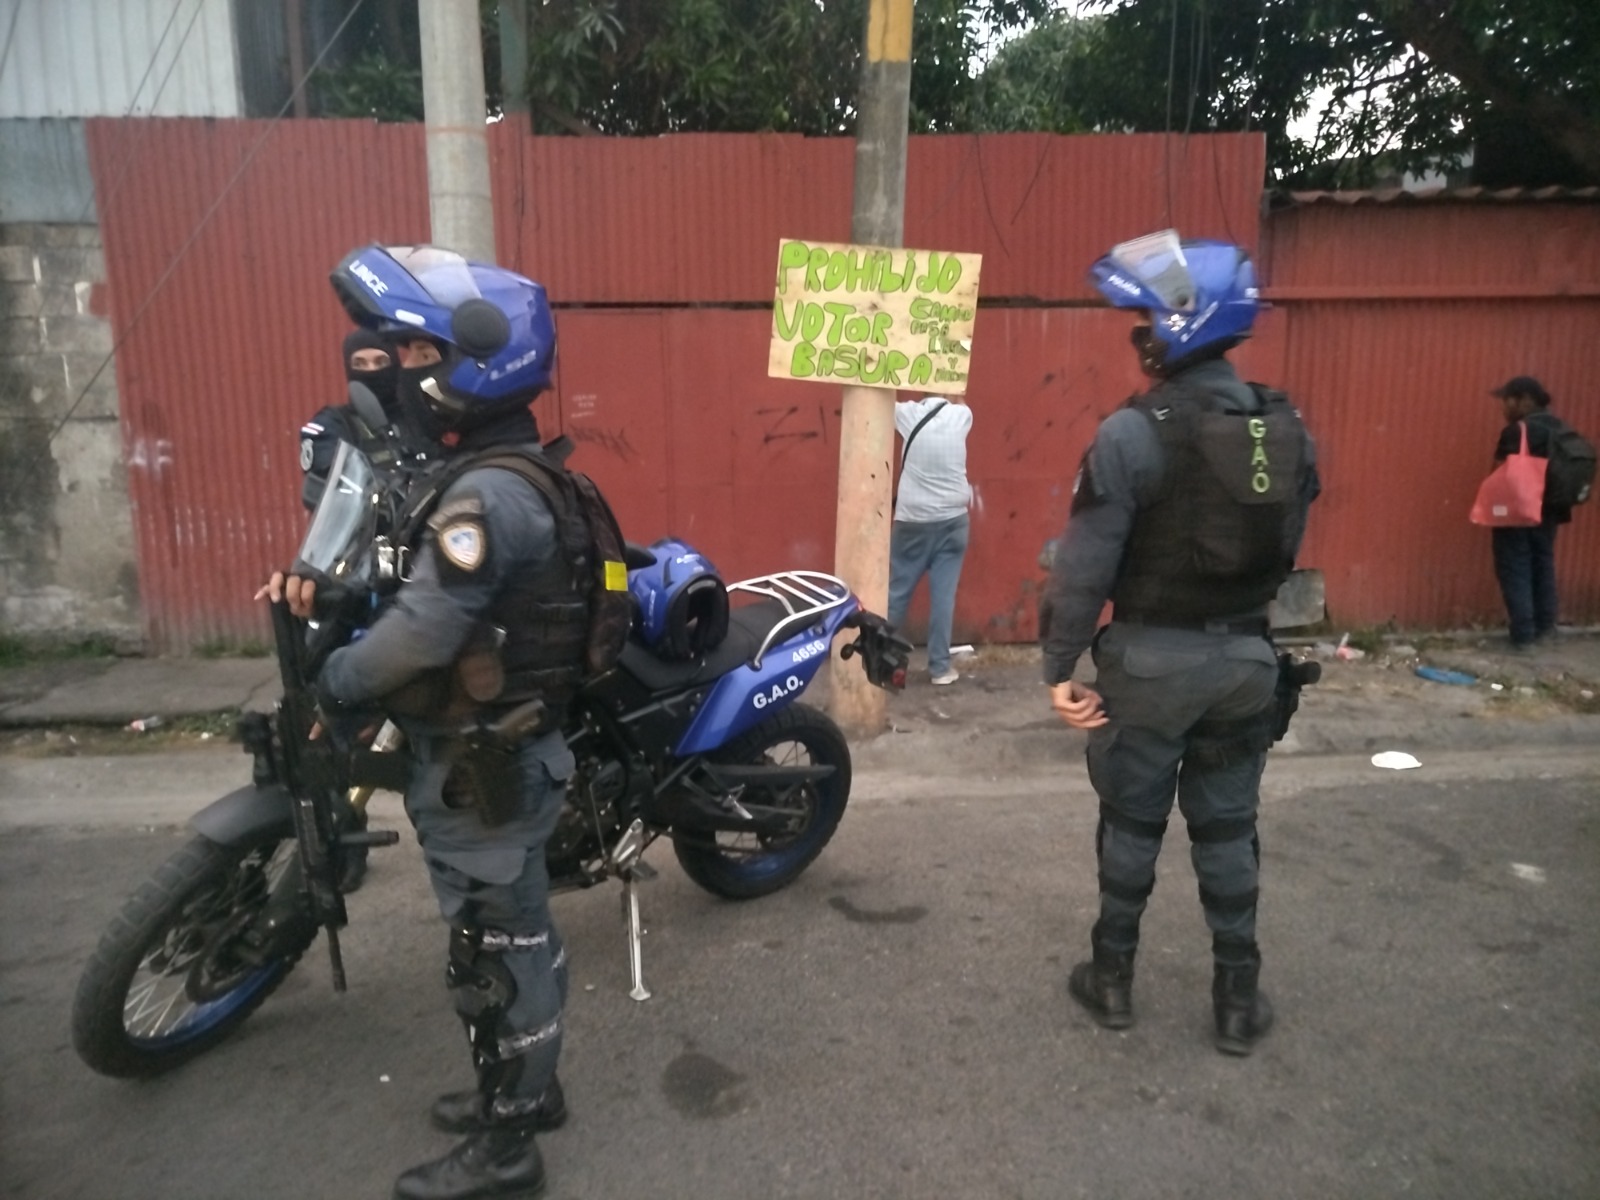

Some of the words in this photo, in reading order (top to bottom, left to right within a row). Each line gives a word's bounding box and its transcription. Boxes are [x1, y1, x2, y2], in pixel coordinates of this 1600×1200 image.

[790, 341, 933, 385] BASURA
[792, 639, 825, 663] 4656
[752, 674, 804, 710] G.A.O.
